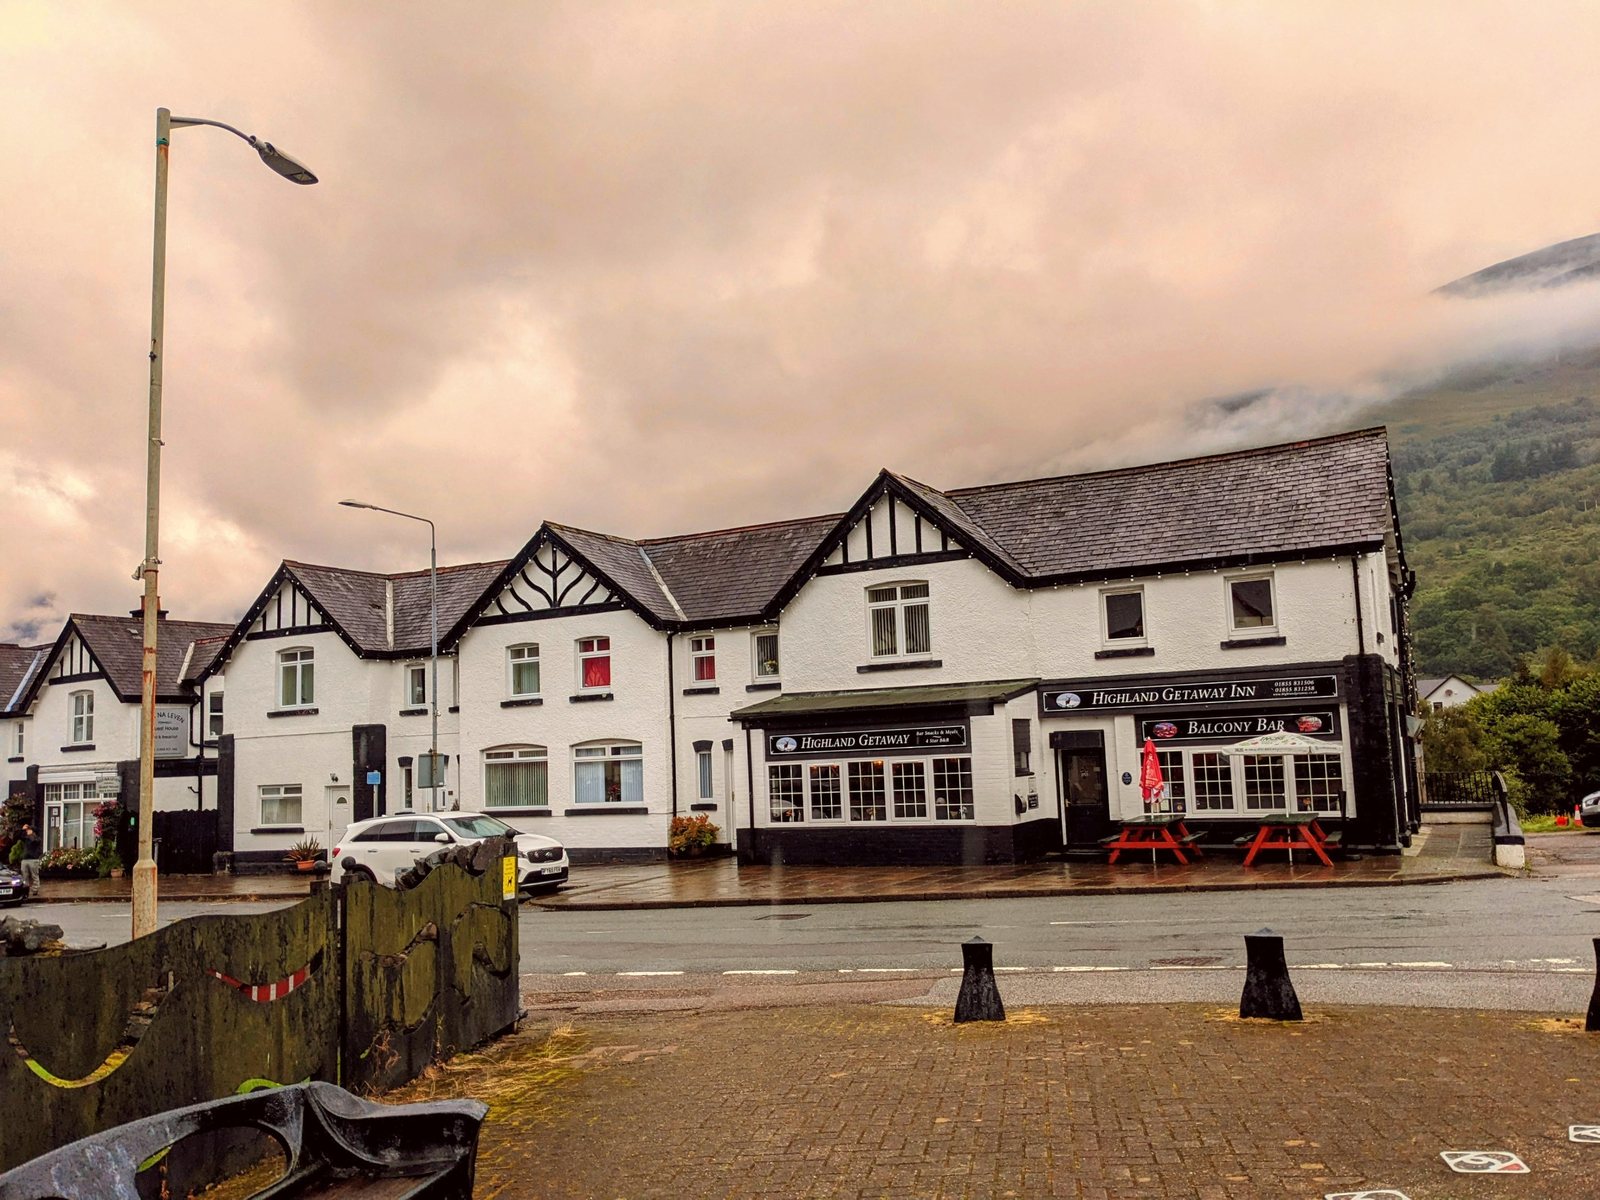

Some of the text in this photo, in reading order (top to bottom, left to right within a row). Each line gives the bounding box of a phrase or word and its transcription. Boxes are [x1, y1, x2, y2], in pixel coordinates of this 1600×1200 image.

[1091, 685, 1257, 705] HIGHLAND GETAWAY INN
[1187, 718, 1285, 735] BALCONY BAR
[801, 734, 911, 749] HIGHLAND GETAWAY
